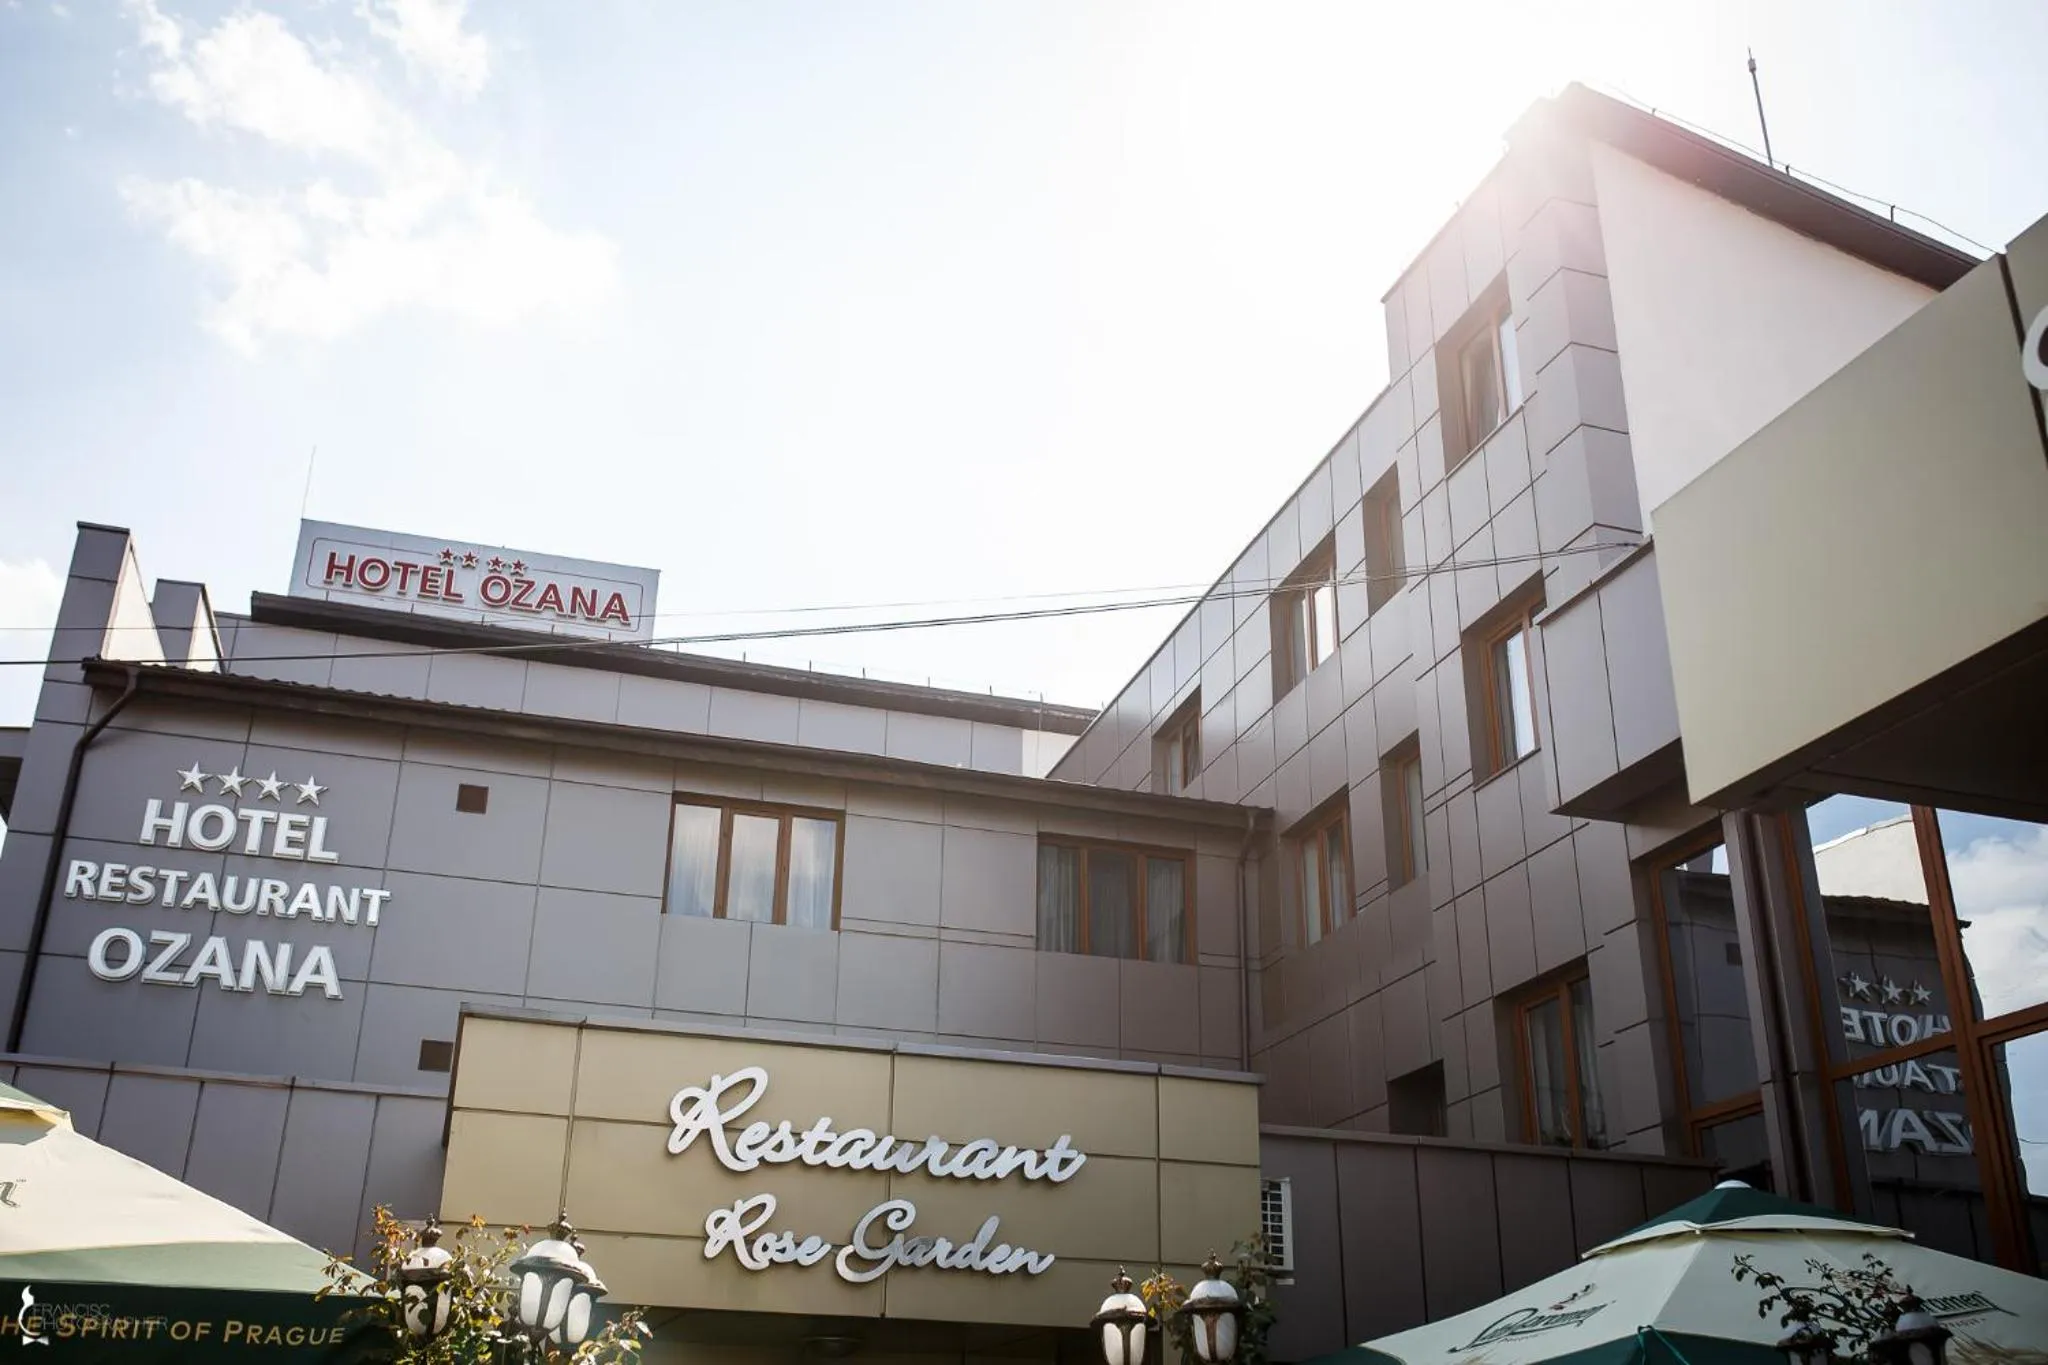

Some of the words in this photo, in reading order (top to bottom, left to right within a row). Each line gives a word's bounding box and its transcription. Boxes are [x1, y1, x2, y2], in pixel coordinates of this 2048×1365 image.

[322, 550, 465, 605] HOTEL
[479, 573, 633, 625] OZANA
[138, 799, 340, 864] HOTEL
[64, 859, 391, 928] RESTAURANT
[87, 927, 344, 1000] OZANA
[667, 1066, 1087, 1184] Restaurant
[704, 1192, 832, 1271] Rose
[836, 1199, 1055, 1283] Garden
[56, 1312, 161, 1339] SPIRIT
[170, 1320, 212, 1342] OF
[223, 1320, 345, 1345] PRAGUE
